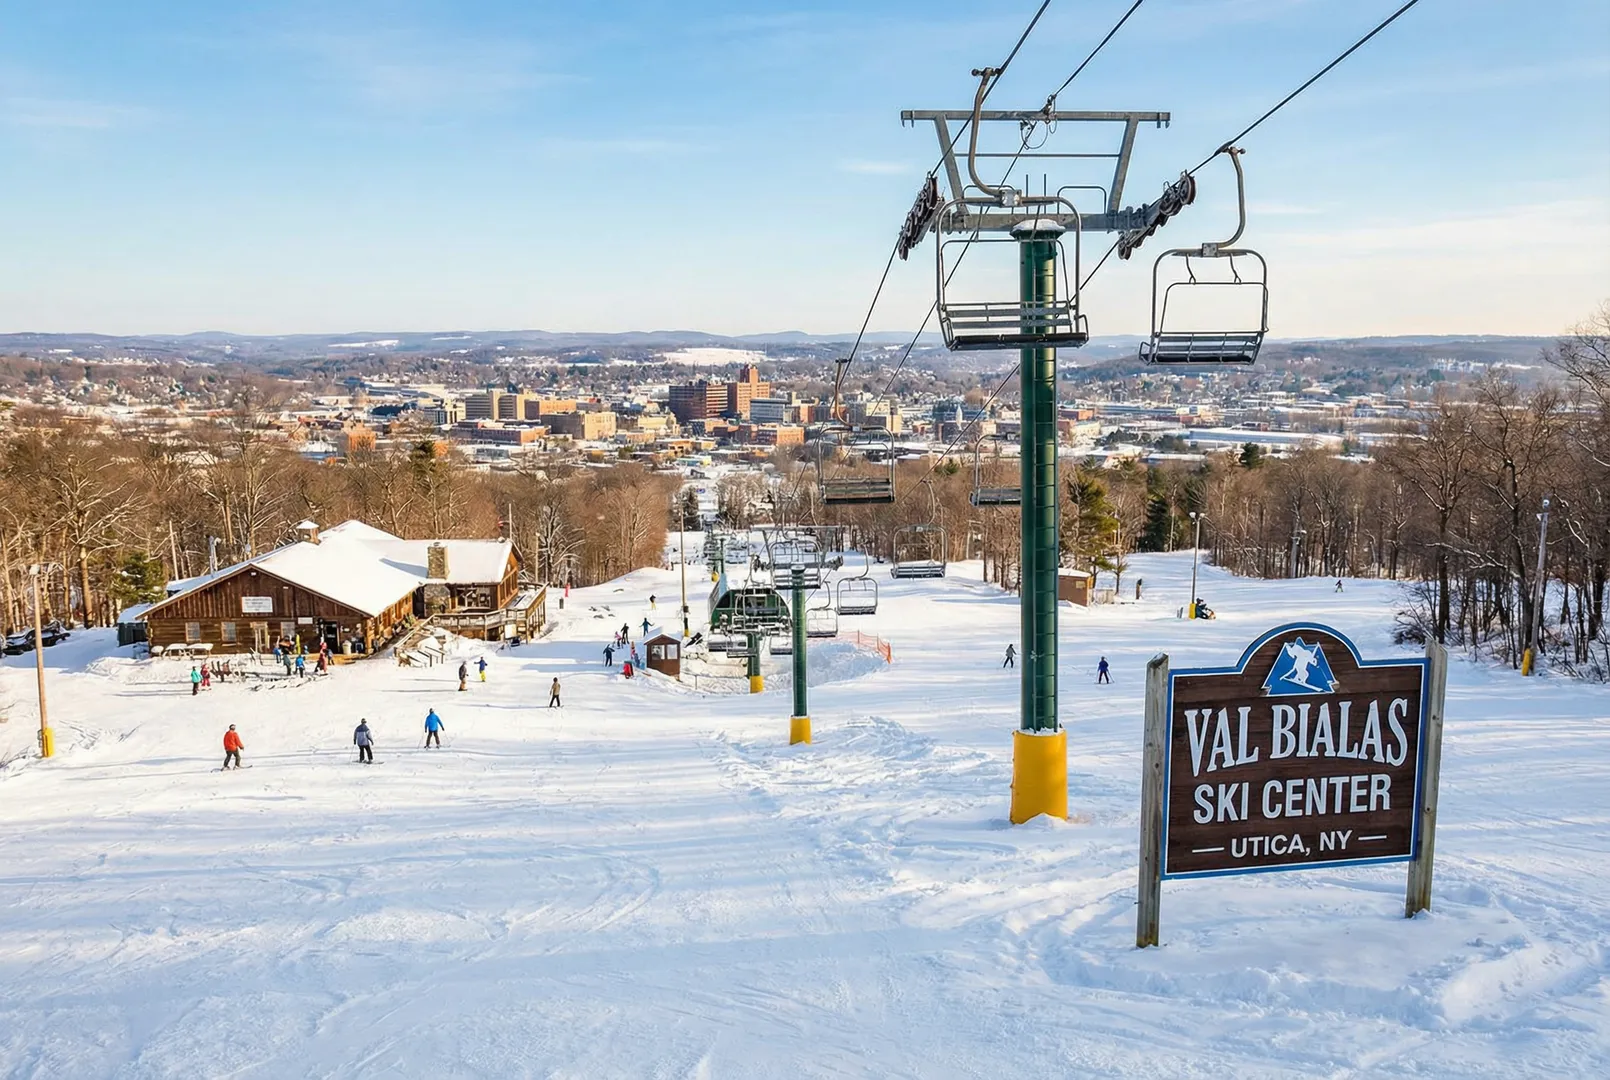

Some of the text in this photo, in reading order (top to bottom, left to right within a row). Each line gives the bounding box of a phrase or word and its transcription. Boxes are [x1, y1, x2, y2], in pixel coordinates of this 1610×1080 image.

[1184, 697, 1408, 777] VAL BIALAS
[1193, 773, 1392, 825] SKI CENTER
[1231, 829, 1353, 858] UTICA, NY
